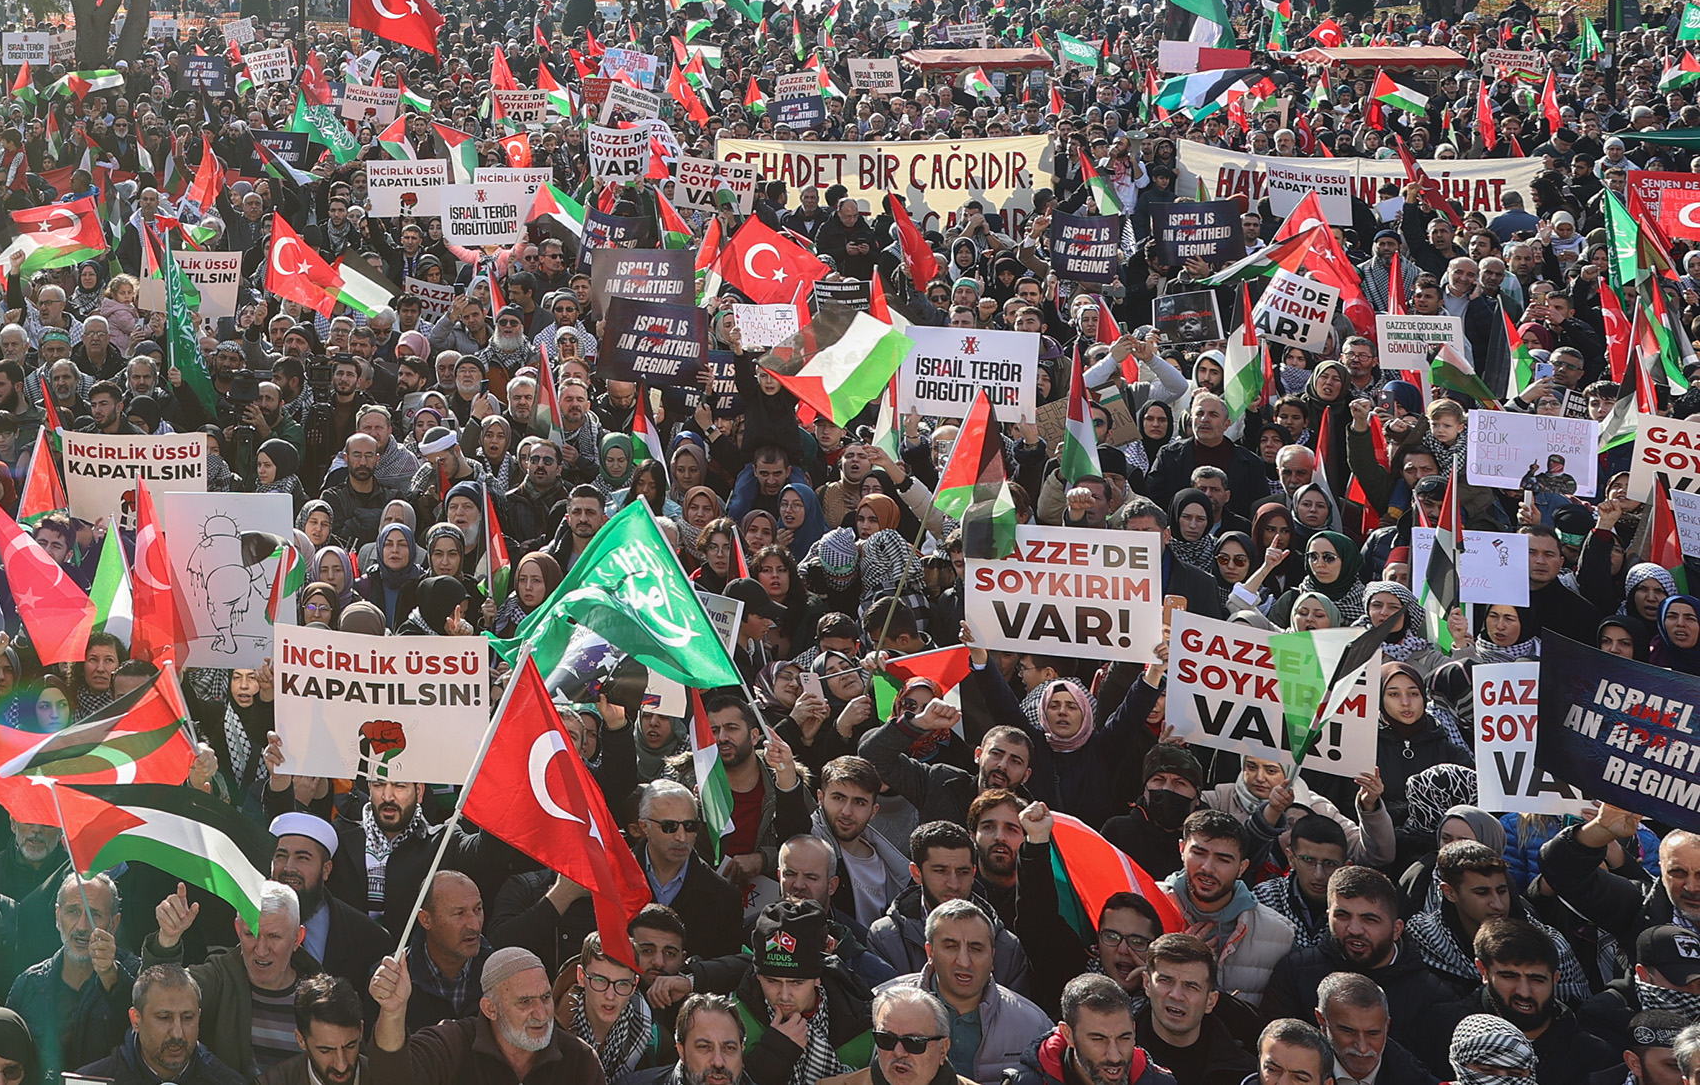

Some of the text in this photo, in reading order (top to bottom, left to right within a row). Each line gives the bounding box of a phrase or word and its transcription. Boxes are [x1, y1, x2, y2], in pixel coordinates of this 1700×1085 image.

[8, 43, 44, 51] İSRAİL TERÖR
[1487, 58, 1533, 67] SOYKIRIM
[1489, 52, 1535, 60] GAZZE'DE
[249, 59, 287, 71] SOYKIRIM
[254, 69, 284, 82] VAR!
[780, 76, 817, 86] GAZZE'DE
[854, 71, 893, 79] İSRAİL TERÖR
[348, 87, 398, 99] İNCİRLİK ÜSSÜ
[778, 84, 816, 93] SOYKIRIM
[345, 95, 396, 105] KAPATILSIN!
[498, 93, 546, 101] GAZZE'DE
[503, 101, 545, 110] OYKIRIM
[781, 104, 802, 112] ISRAEL
[286, 140, 293, 149] IS
[590, 129, 648, 145] GAZZE'DE
[590, 142, 648, 158] SOYKIRIM
[370, 164, 444, 176] İNCİRLİK ÜSSÜ
[595, 158, 644, 176] VAR!
[859, 148, 901, 191] BİR
[370, 177, 445, 187] KAPATILSIN!
[477, 173, 550, 182] İNCİRLİK ÜSSÜ
[1268, 167, 1346, 185] İNCİRLİK ÜSSÜ
[1641, 178, 1682, 189] SENDEN
[450, 203, 517, 220] İSRAİL TERÖR
[1169, 212, 1214, 227] ISRAEL IS
[451, 220, 518, 236] ÖRGÜTÜDÜR!
[614, 227, 625, 238] IS
[1062, 225, 1110, 242] ISRAEL IS
[1162, 226, 1231, 242] AN APARTHEID
[1054, 240, 1065, 254] AN
[1178, 243, 1217, 257] REGIME
[205, 257, 238, 271] ÜSSÜ
[616, 261, 669, 276] ISRAEL IS
[1067, 258, 1109, 274] REGIME
[604, 279, 684, 295] AN APARTHEID
[634, 315, 689, 336] ISRAEL IS
[1256, 310, 1310, 344] AR!
[1418, 321, 1452, 332] ÇOCUKLAR
[1431, 332, 1454, 342] BİRLİKTE
[616, 333, 700, 358] AN APARTHEID
[632, 355, 681, 375] REGIME
[916, 353, 1022, 383] İSRAİL TERÖR
[1567, 421, 1589, 436] EBU
[68, 440, 201, 461] İNCİRLİK ÜSSÜ
[68, 459, 202, 481] KAPATILSIN!
[1001, 540, 1149, 570] AZZE'DE
[974, 567, 1151, 603] SOYKIRIM
[991, 600, 1131, 649] VAR!
[282, 639, 479, 676] İNCİRLİK ÜSSÜ
[281, 672, 482, 708] KAPATILSIN!
[1594, 678, 1694, 735] ISRAEL
[1191, 692, 1342, 762] VAR!
[1563, 704, 1604, 739] AN
